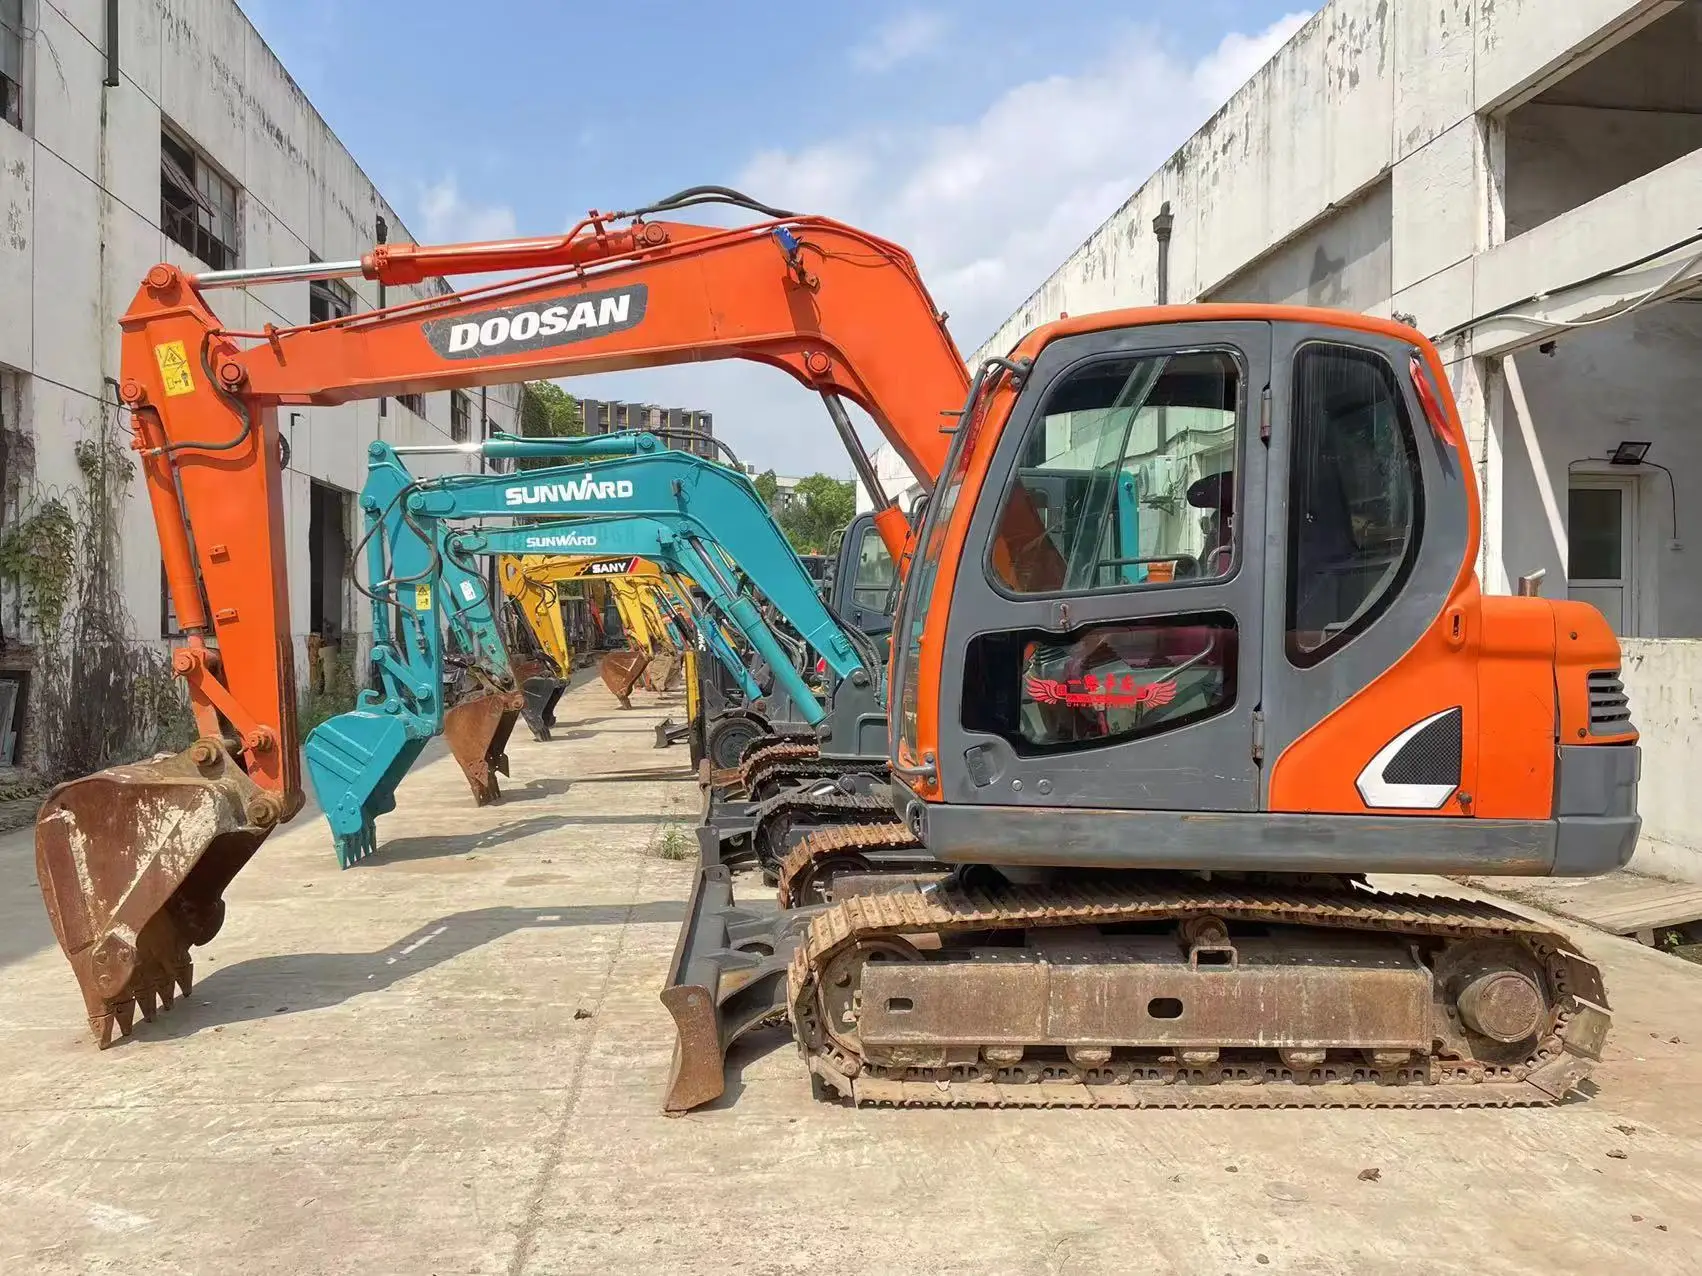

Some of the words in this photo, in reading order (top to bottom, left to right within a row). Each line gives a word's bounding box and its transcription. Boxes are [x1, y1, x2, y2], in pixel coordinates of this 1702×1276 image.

[449, 294, 631, 353] DOOSAN
[505, 473, 634, 506] SUNWARD
[526, 531, 597, 548] SUNWARD
[592, 562, 627, 574] SANY
